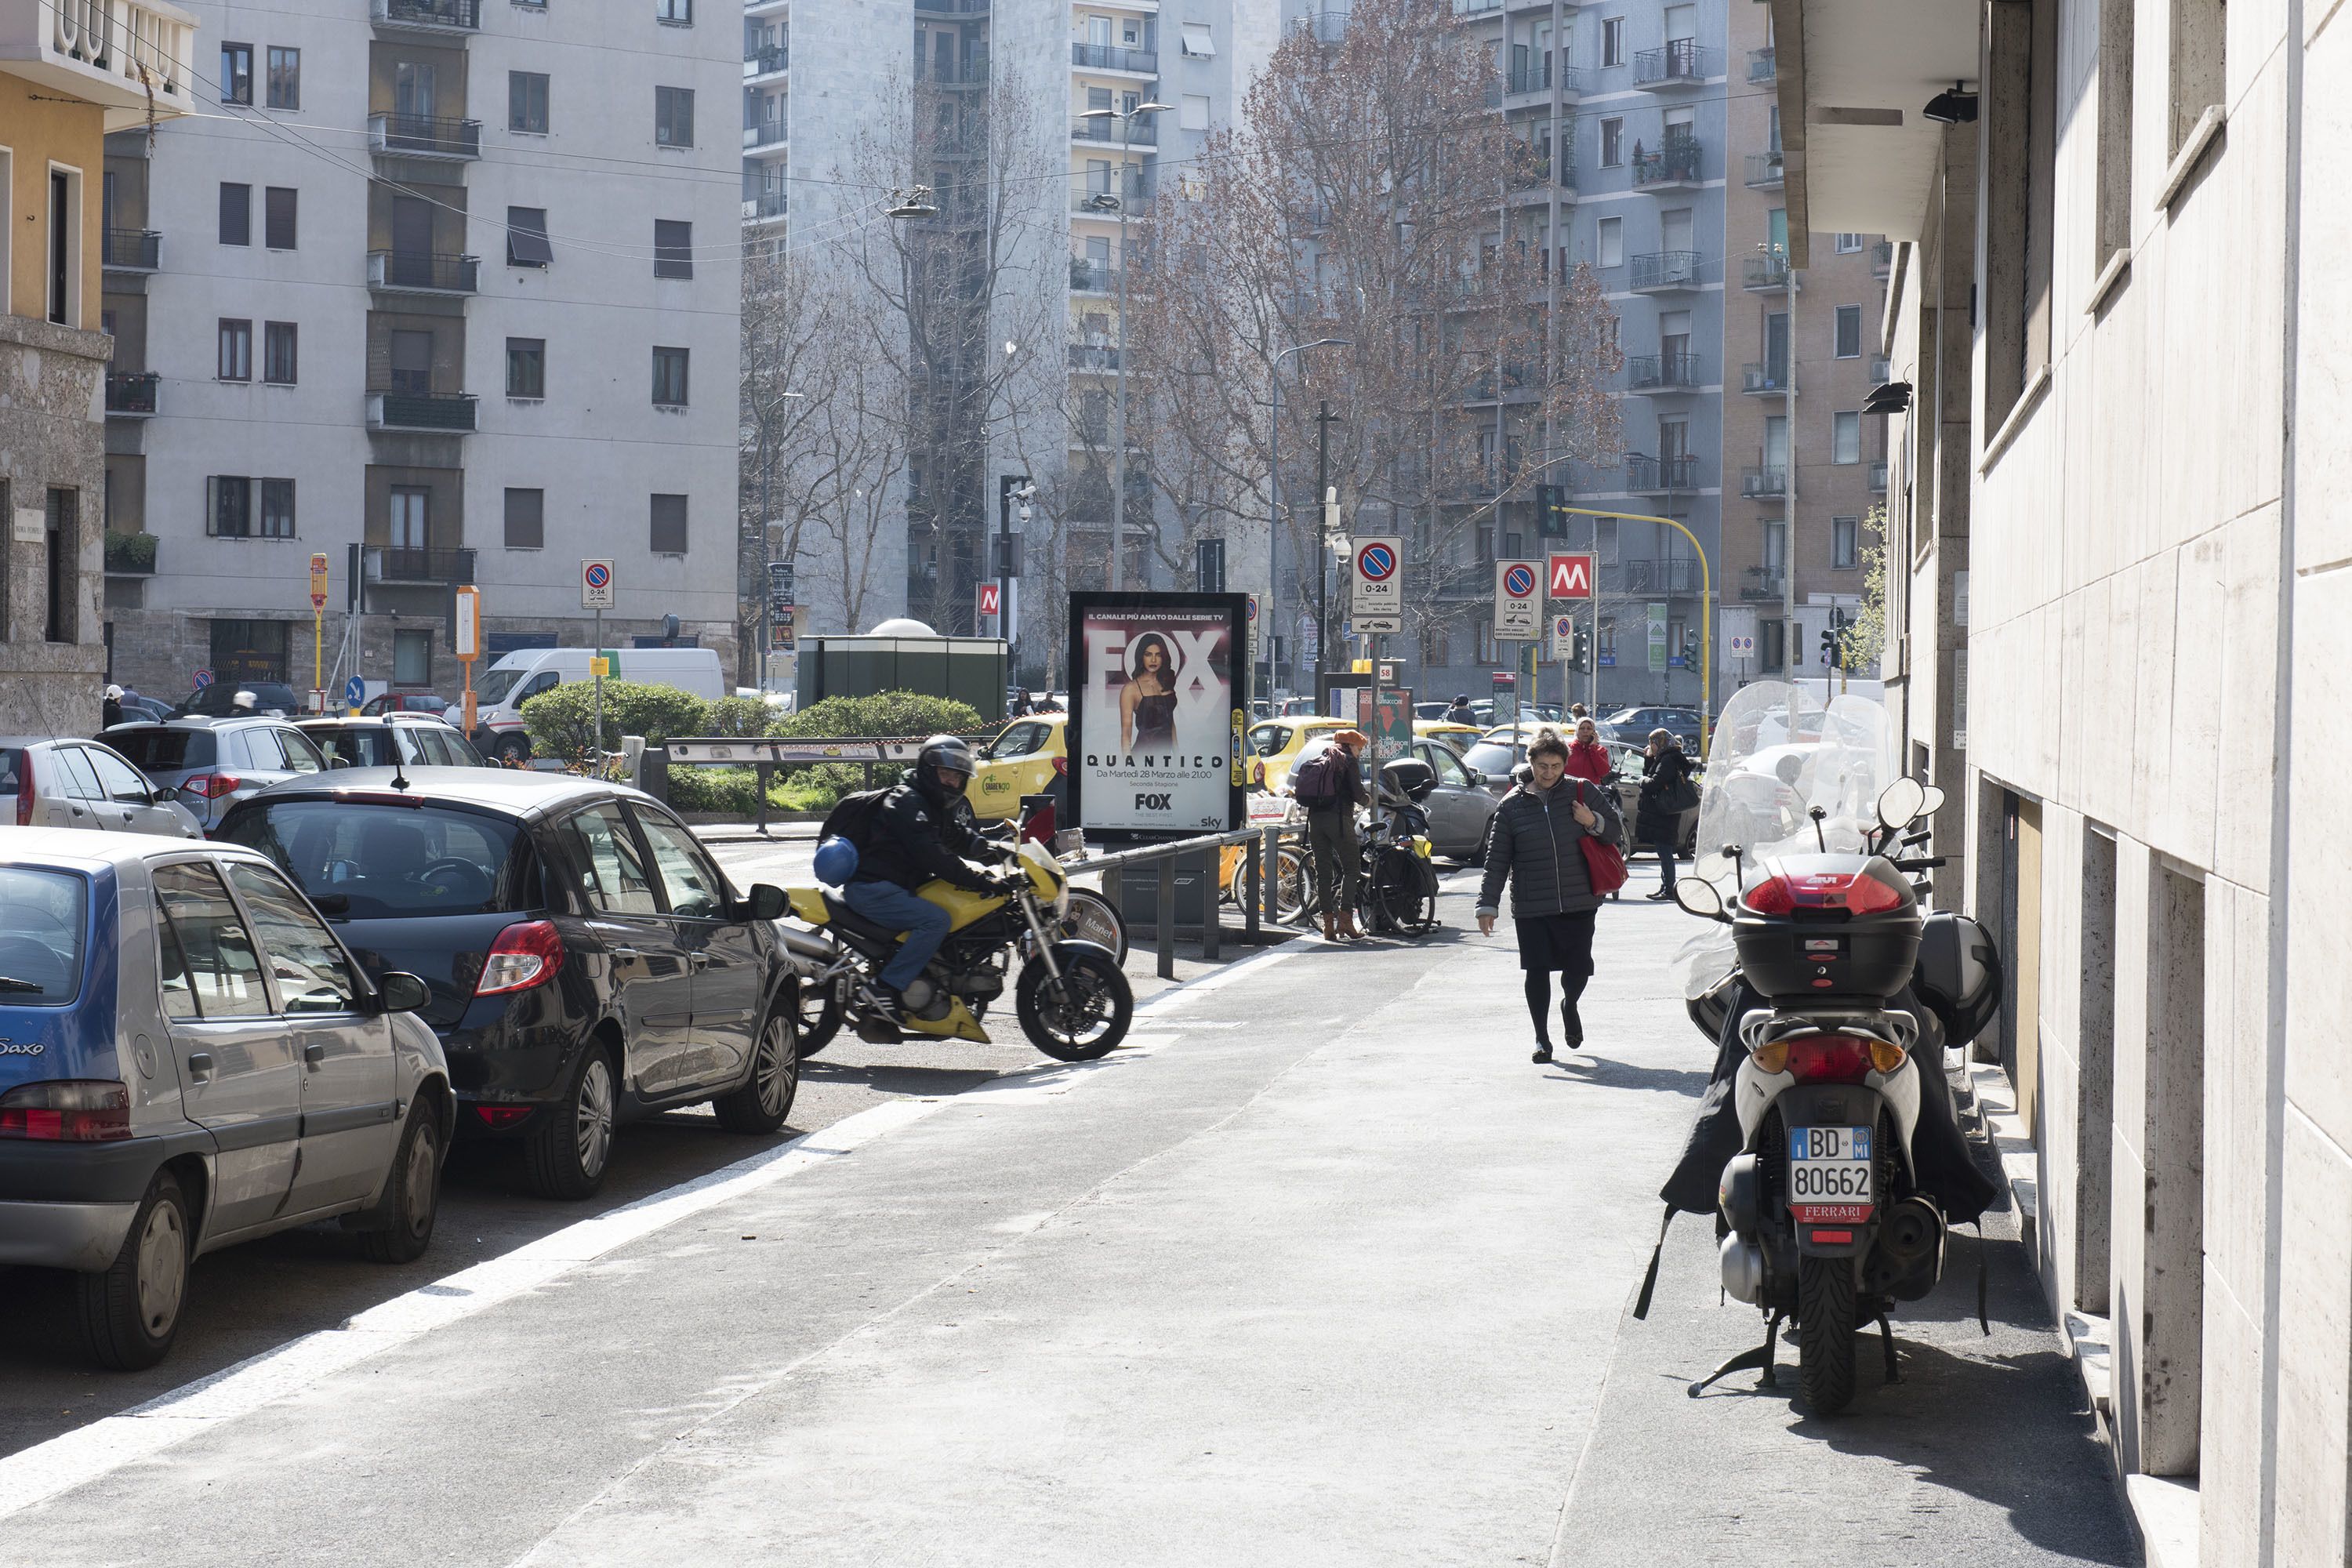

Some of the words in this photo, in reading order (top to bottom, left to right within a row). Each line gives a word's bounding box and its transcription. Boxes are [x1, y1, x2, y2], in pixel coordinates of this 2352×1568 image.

[1552, 564, 1588, 590] M
[1087, 630, 1225, 691] FOX
[1087, 754, 1223, 768] QUANTICO
[1109, 770, 1138, 779] Martedì
[1134, 793, 1172, 810] FOX
[1200, 816, 1223, 829] sky
[1085, 917, 1113, 939] Manet
[1810, 1129, 1839, 1157] BD
[1855, 1144, 1868, 1158] MI
[1795, 1167, 1870, 1196] 80662
[1805, 1207, 1861, 1217] FERRARI
